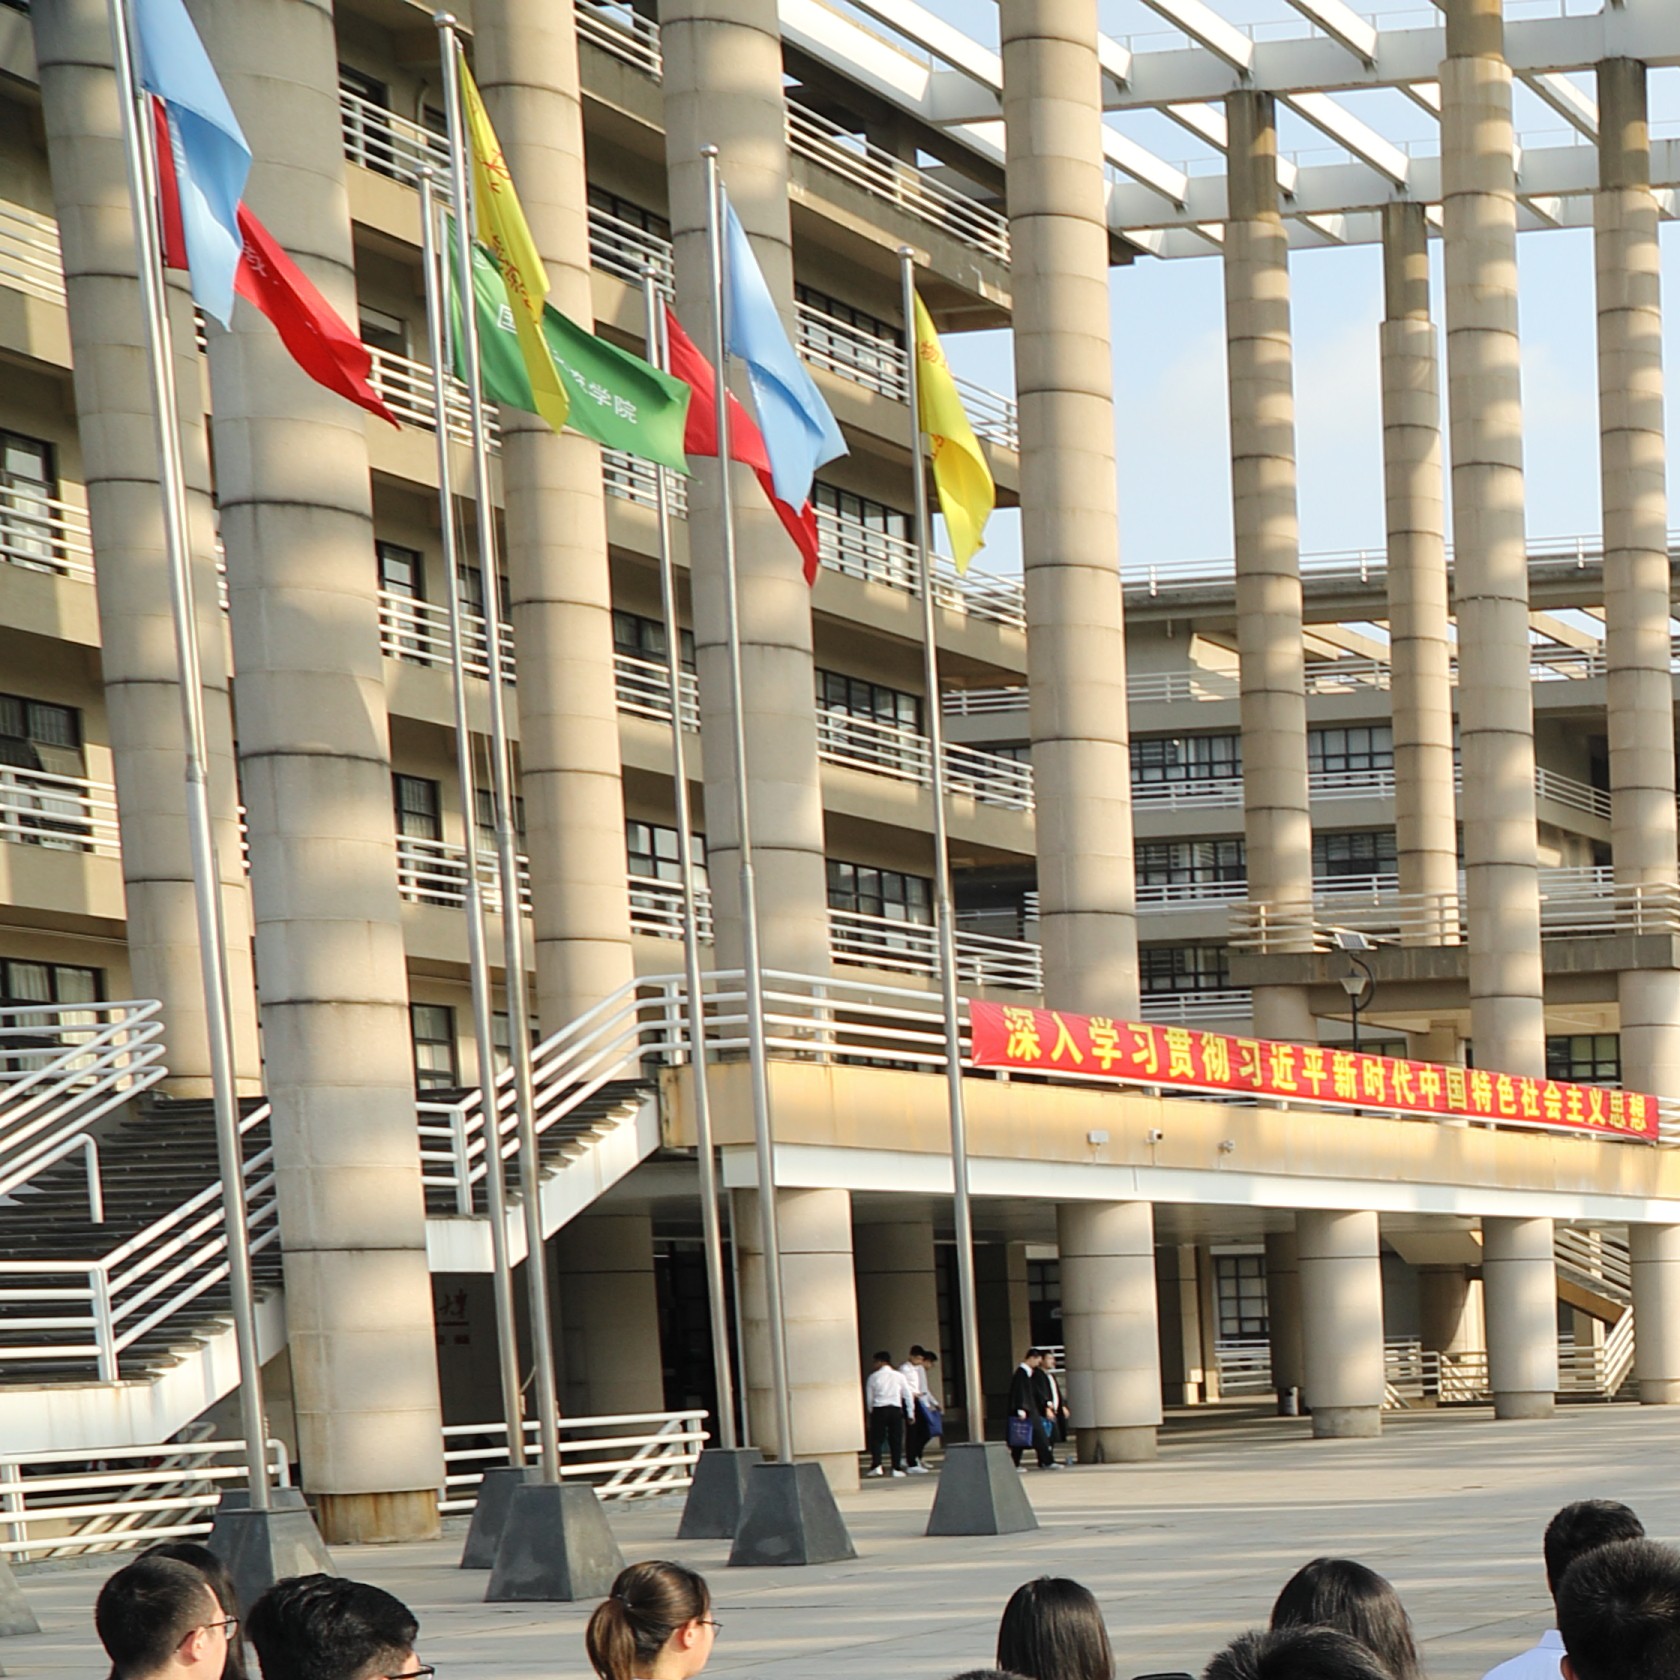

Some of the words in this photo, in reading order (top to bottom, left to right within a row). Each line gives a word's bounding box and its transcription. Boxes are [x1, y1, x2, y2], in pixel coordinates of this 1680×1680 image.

[1001, 1005, 1649, 1134] 深入学习贯彻习近平新时代中国特色社会主义思想
